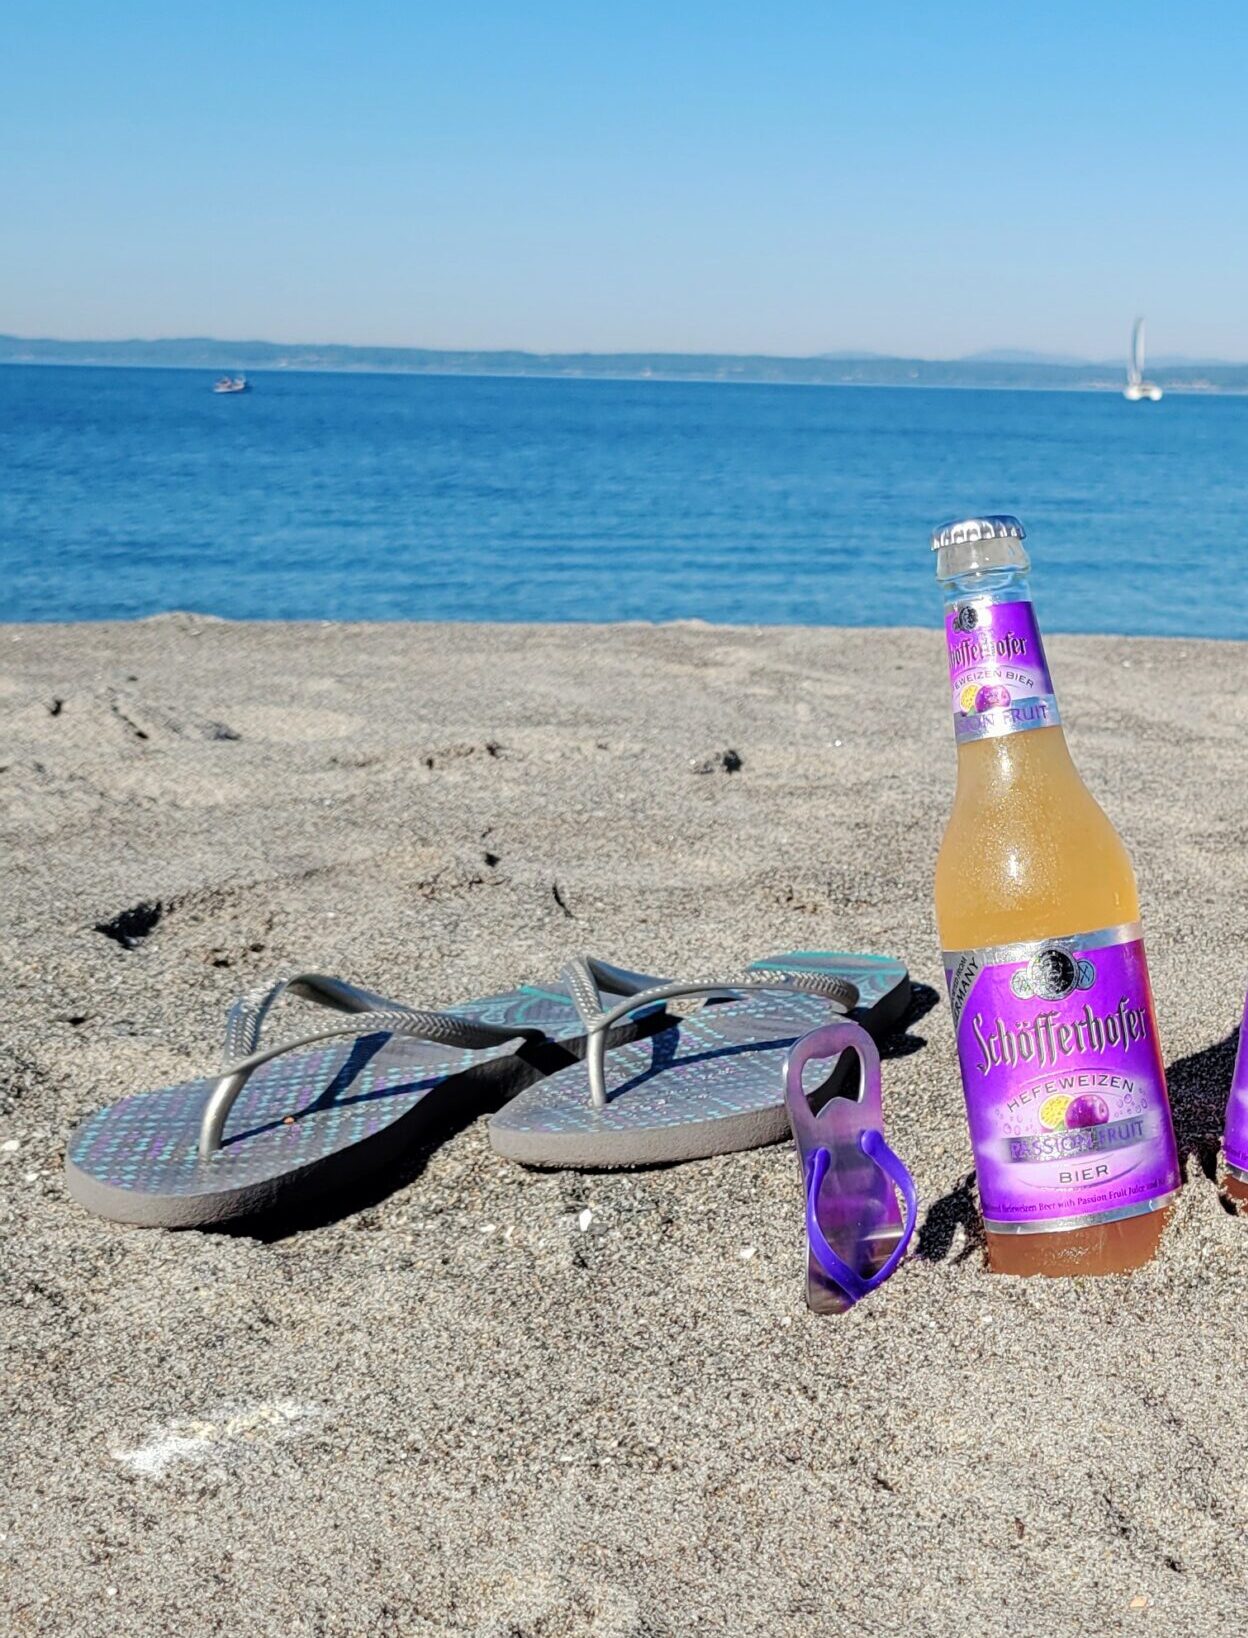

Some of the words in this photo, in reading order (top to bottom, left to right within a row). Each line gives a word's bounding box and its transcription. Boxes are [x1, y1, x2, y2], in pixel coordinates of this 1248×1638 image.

[954, 670, 1002, 690] EWEIZEN
[1006, 671, 1034, 688] BIER
[973, 995, 1147, 1076] Schöfferhofer
[1007, 1074, 1134, 1111] HEFEWEIZEN
[1009, 1133, 1093, 1160] PASSION
[1098, 1120, 1144, 1144] FRUIT
[1059, 1164, 1108, 1184] BIER
[1077, 1194, 1107, 1206] Passion
[1109, 1190, 1127, 1201] Fruit
